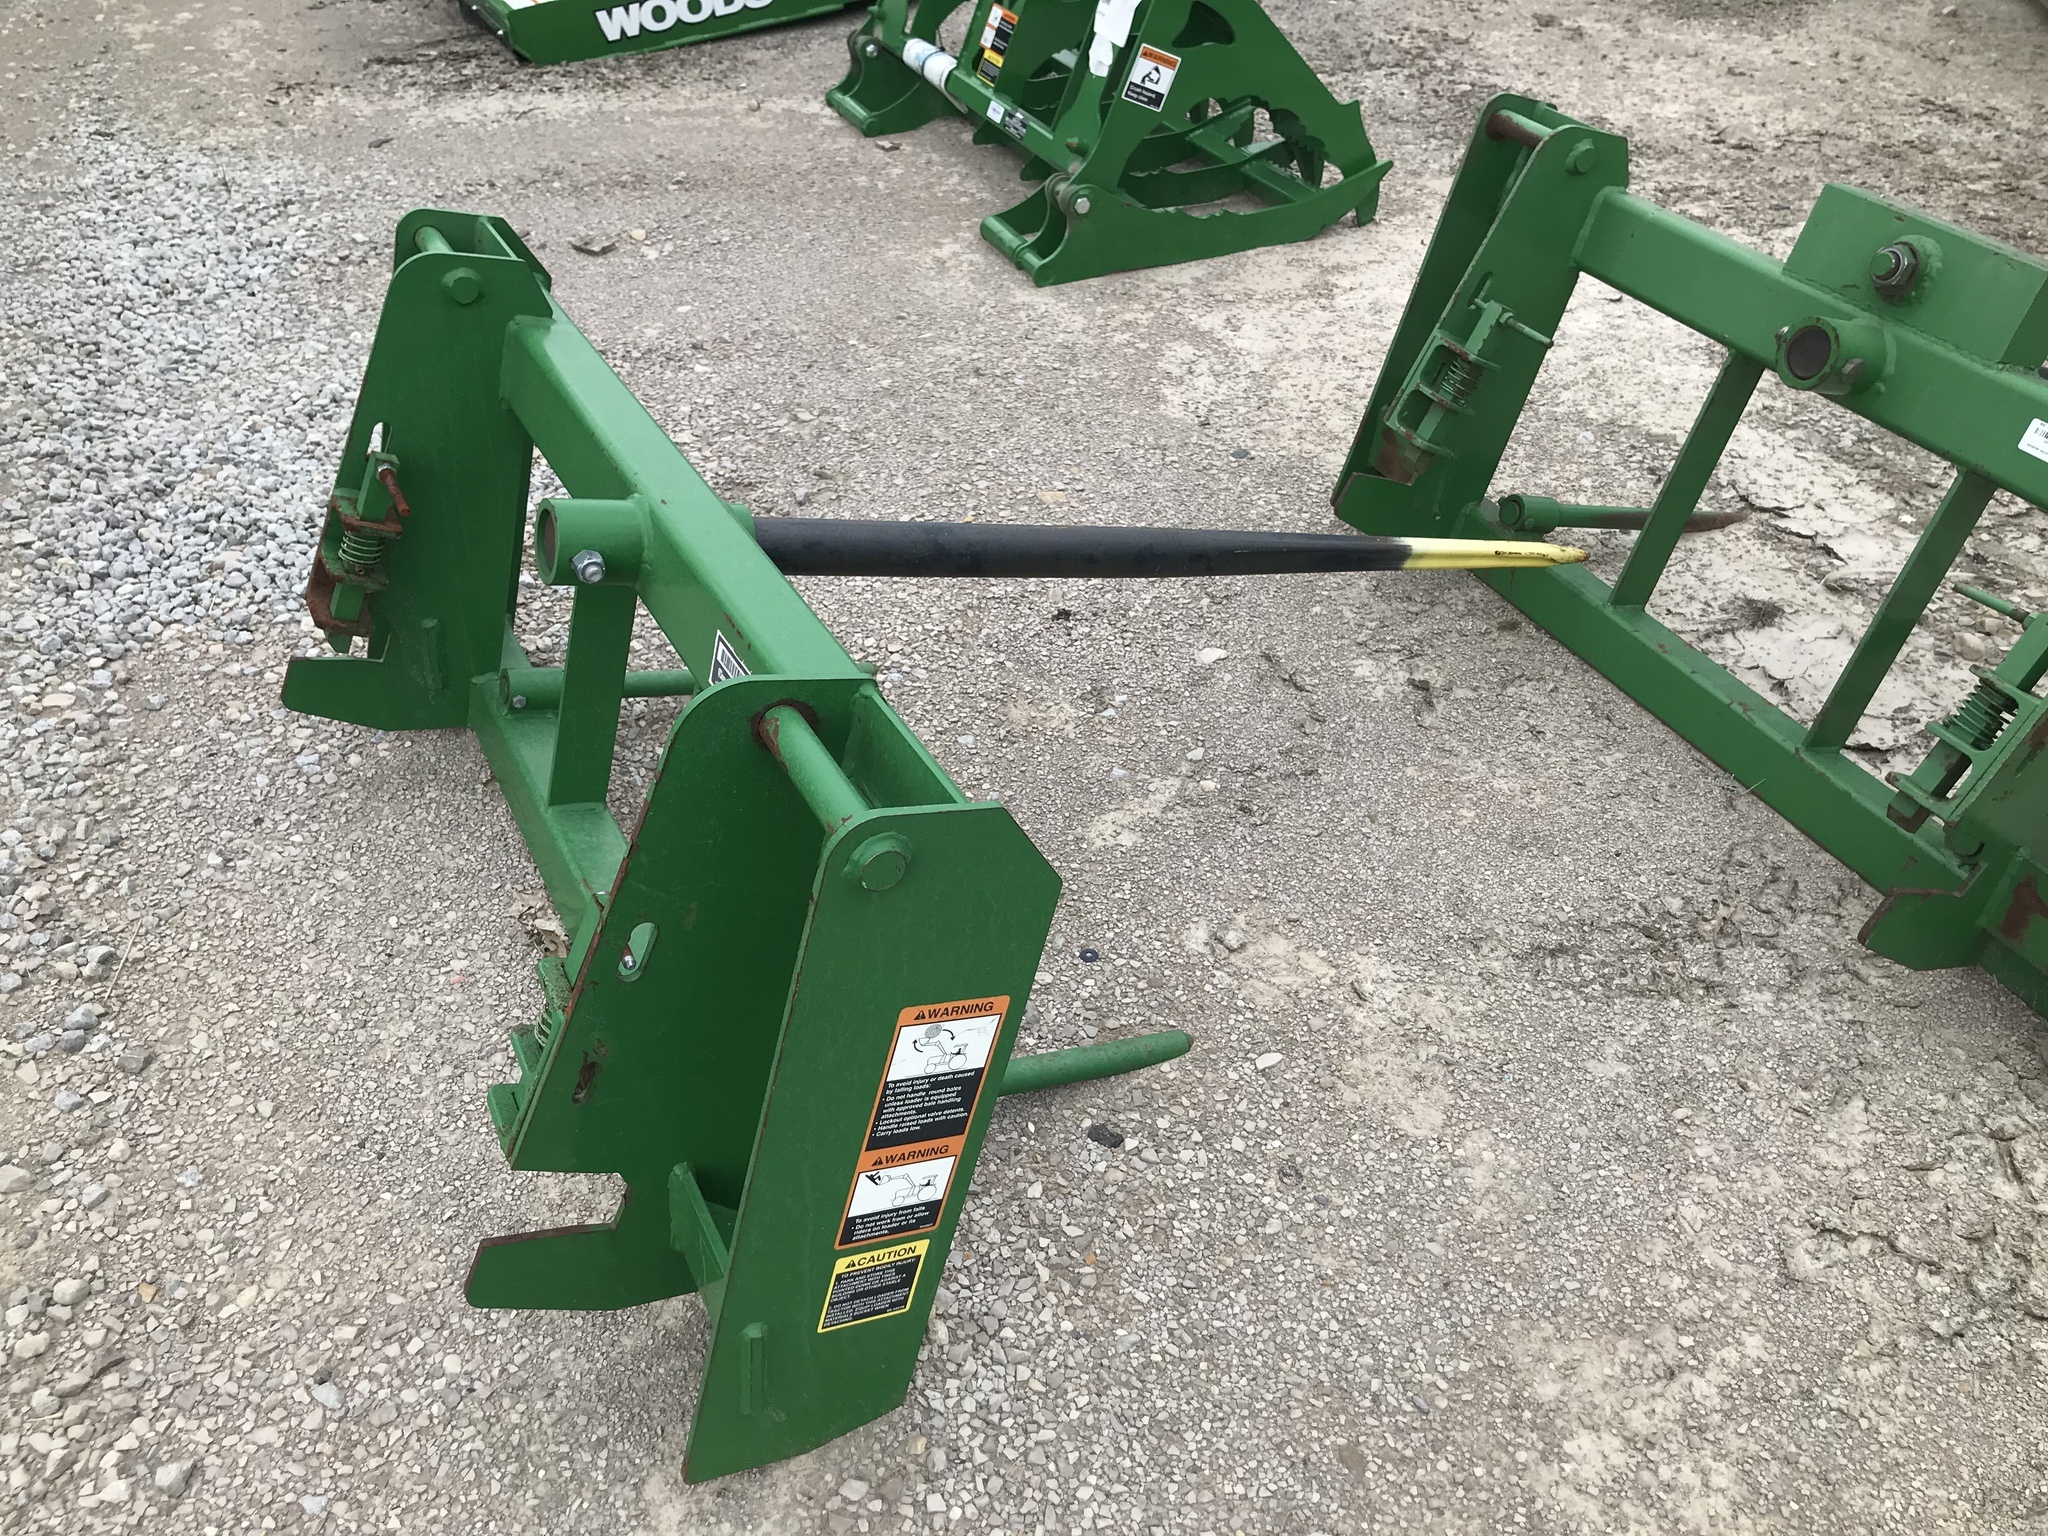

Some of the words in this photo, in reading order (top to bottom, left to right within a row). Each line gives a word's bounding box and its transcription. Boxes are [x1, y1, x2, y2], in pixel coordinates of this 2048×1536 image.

[594, 0, 774, 42] WOOD
[928, 1002, 994, 1019] WARNING
[930, 1092, 957, 1100] equipped
[896, 1103, 923, 1112] approved
[881, 1110, 917, 1119] attachments.
[904, 1113, 926, 1121] optional
[885, 1145, 949, 1164] WARNING
[857, 1246, 916, 1266] CAUTION
[850, 1267, 875, 1276] PREVENT
[834, 1279, 867, 1290] ATTACHMENT
[874, 1291, 894, 1299] LOADER
[877, 1291, 909, 1303] ATTACHMENT
